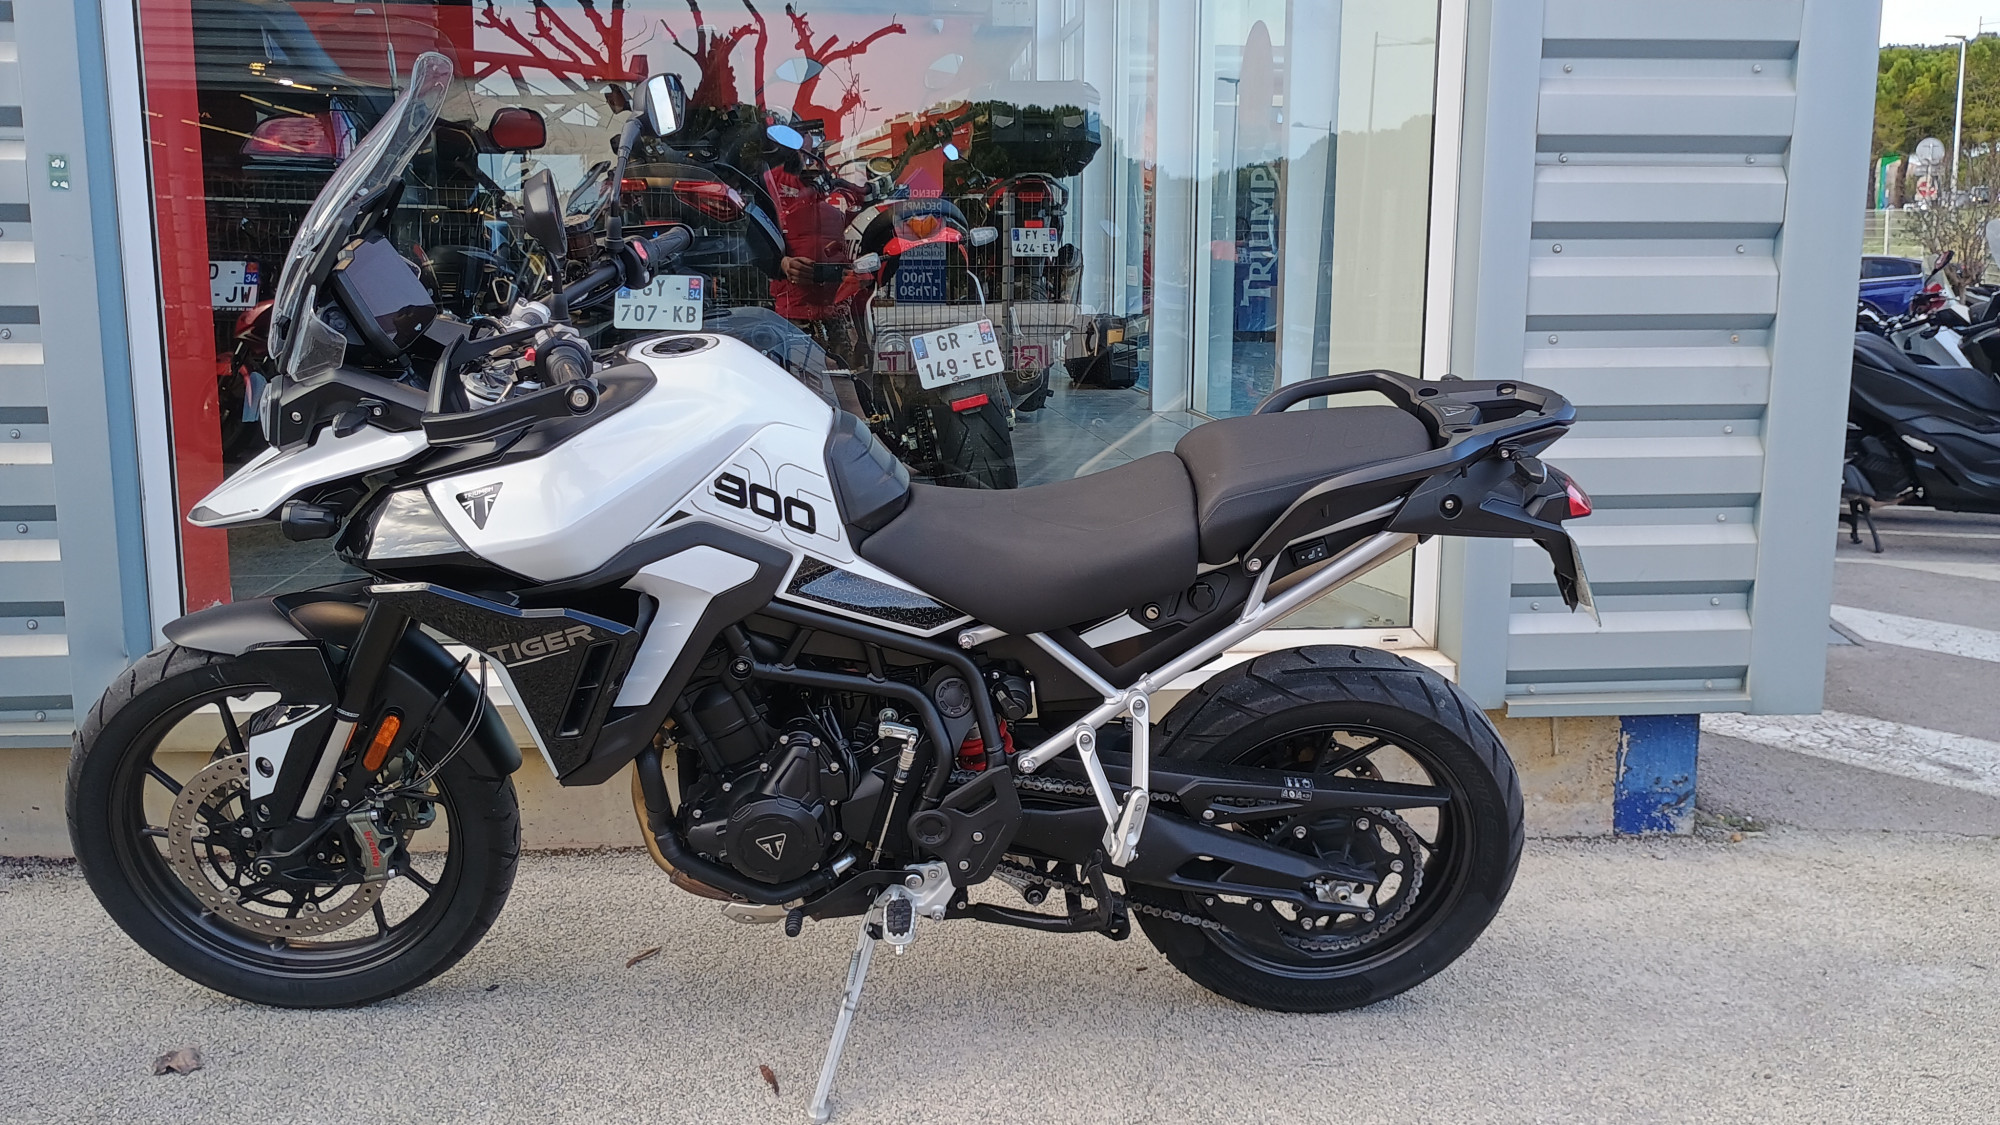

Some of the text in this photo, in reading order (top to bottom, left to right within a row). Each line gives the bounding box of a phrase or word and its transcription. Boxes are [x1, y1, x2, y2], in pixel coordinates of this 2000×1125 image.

[1025, 230, 1038, 240] FY
[245, 273, 258, 283] 34
[689, 289, 701, 300] 34
[936, 332, 960, 352] GR
[981, 332, 994, 343] 34
[713, 471, 817, 535] 900
[486, 624, 596, 663] TIGER
[363, 830, 382, 868] brembo
